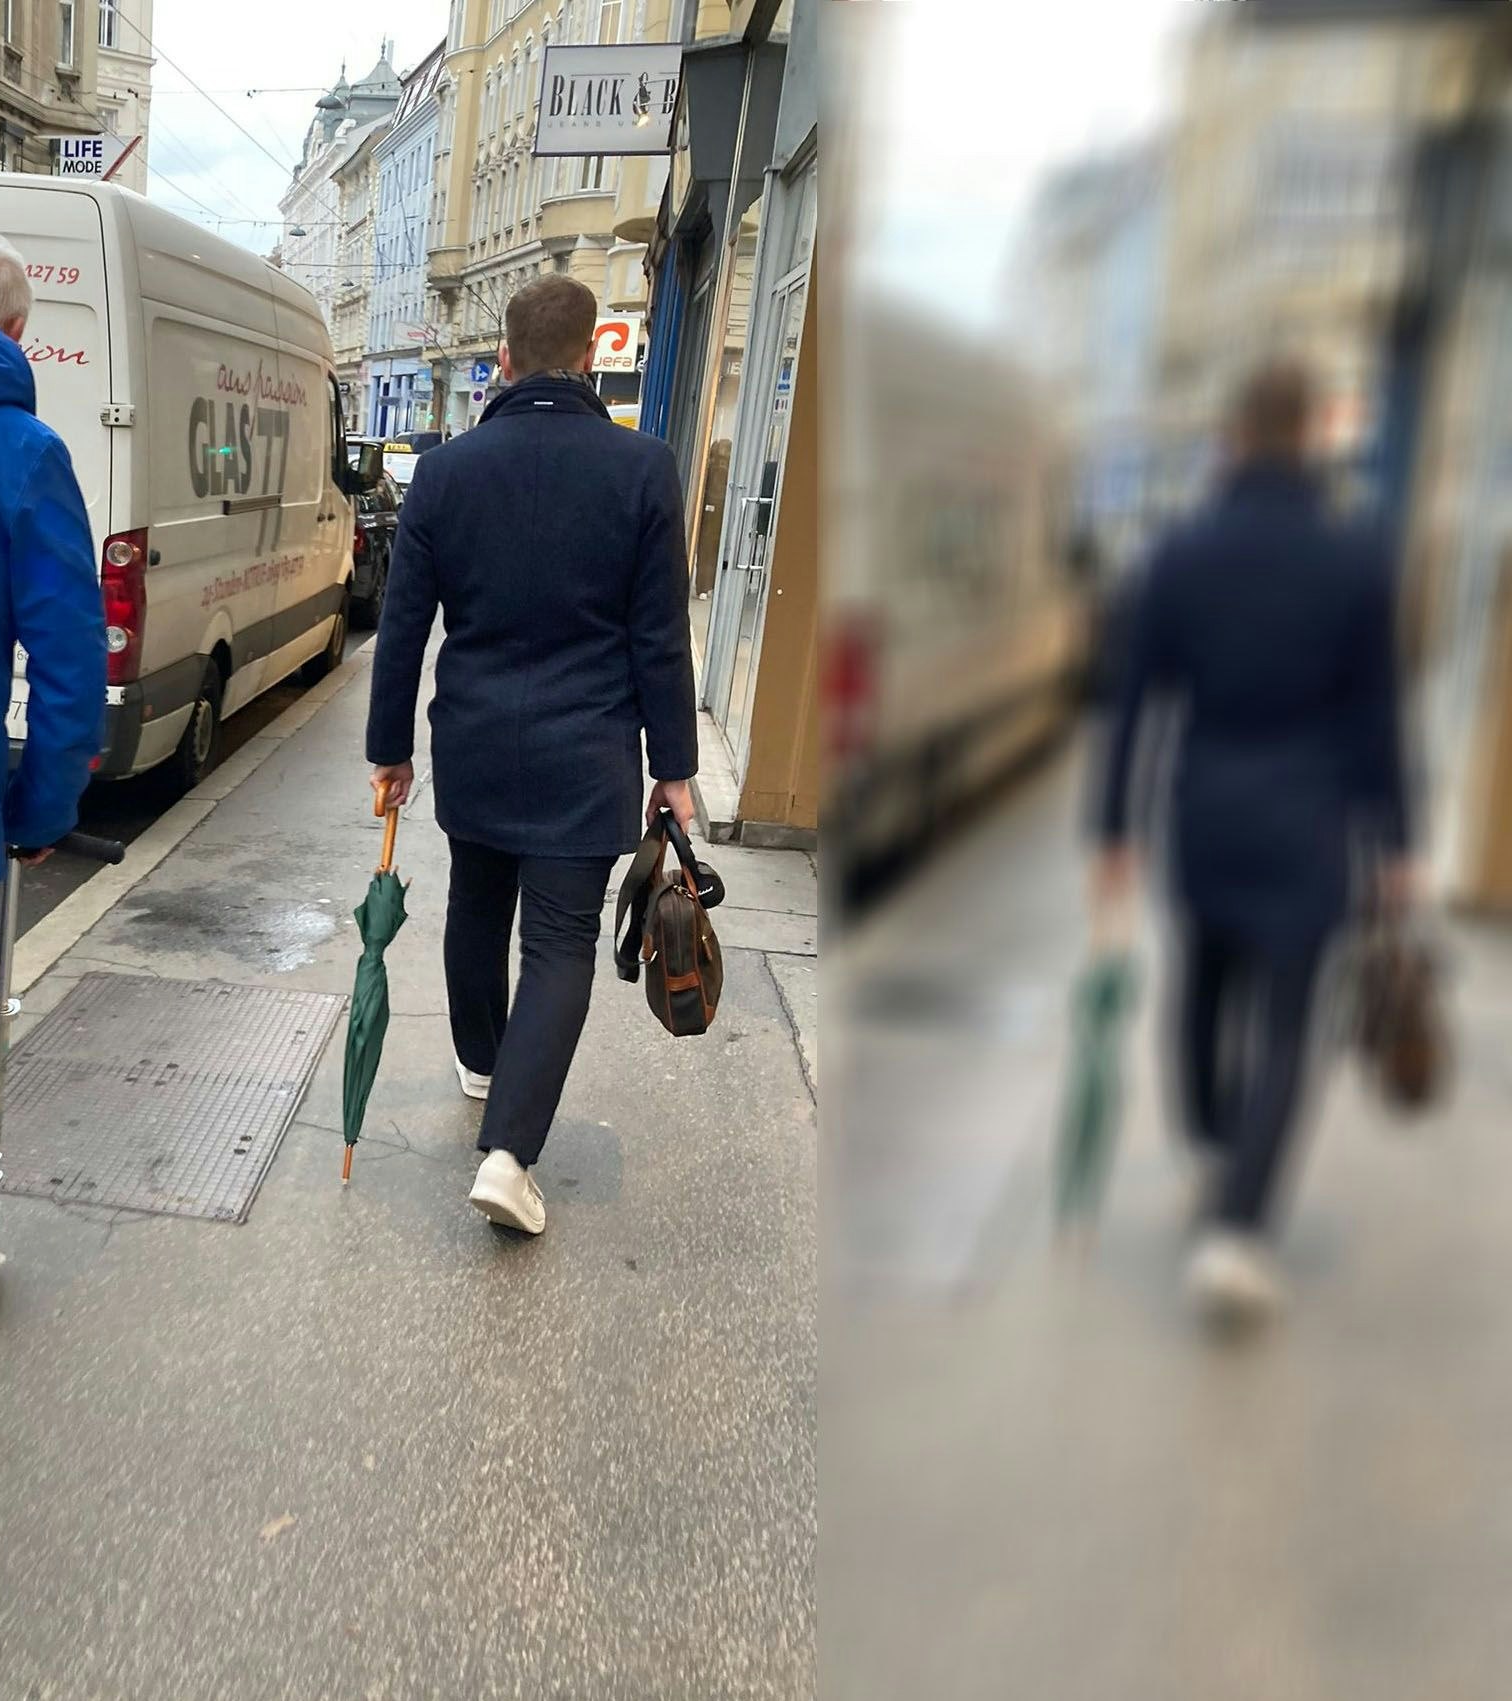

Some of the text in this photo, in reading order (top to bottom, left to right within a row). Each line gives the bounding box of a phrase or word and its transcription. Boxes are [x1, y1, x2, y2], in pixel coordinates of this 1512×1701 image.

[549, 75, 624, 116] BLACK
[662, 79, 677, 114] B
[64, 140, 103, 157] LIFE
[63, 160, 102, 173] MODE
[56, 267, 80, 284] 59
[189, 396, 290, 557] GLAS 77
